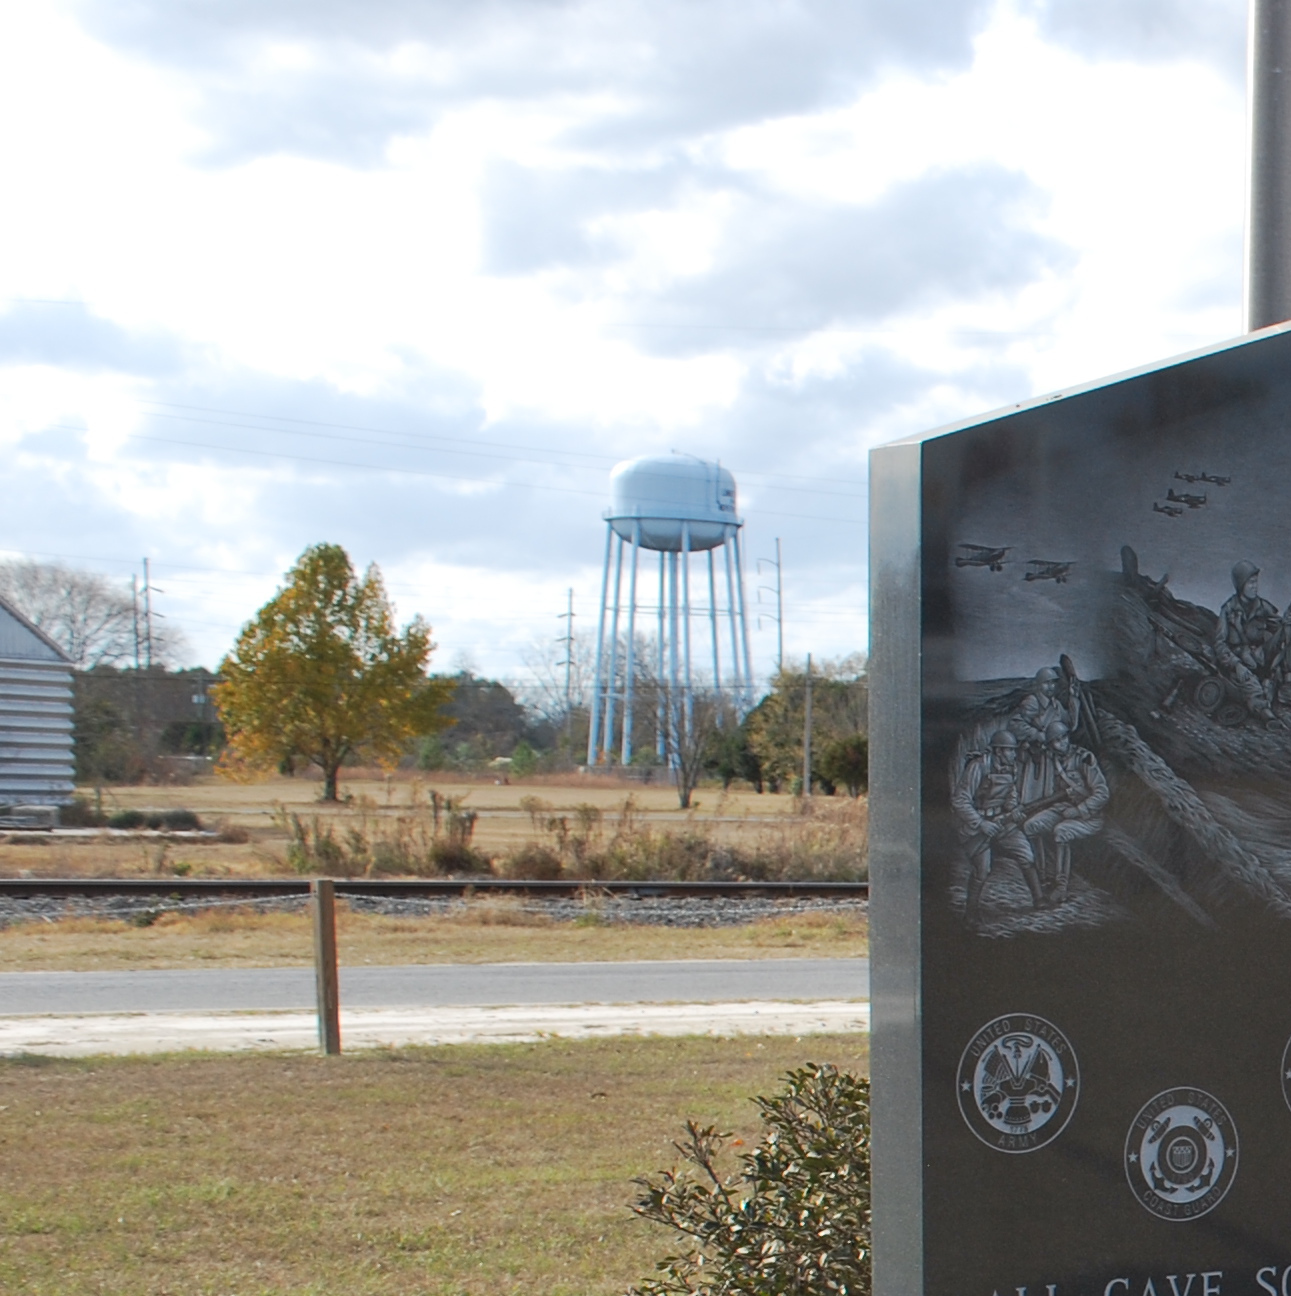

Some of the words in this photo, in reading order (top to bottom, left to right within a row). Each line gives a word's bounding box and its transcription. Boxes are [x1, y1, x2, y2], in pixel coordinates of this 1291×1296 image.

[970, 1020, 1011, 1057] UNITED
[1024, 1018, 1068, 1055] STATES
[1136, 1093, 1175, 1130] UNITED
[998, 1132, 1038, 1148] ARMY
